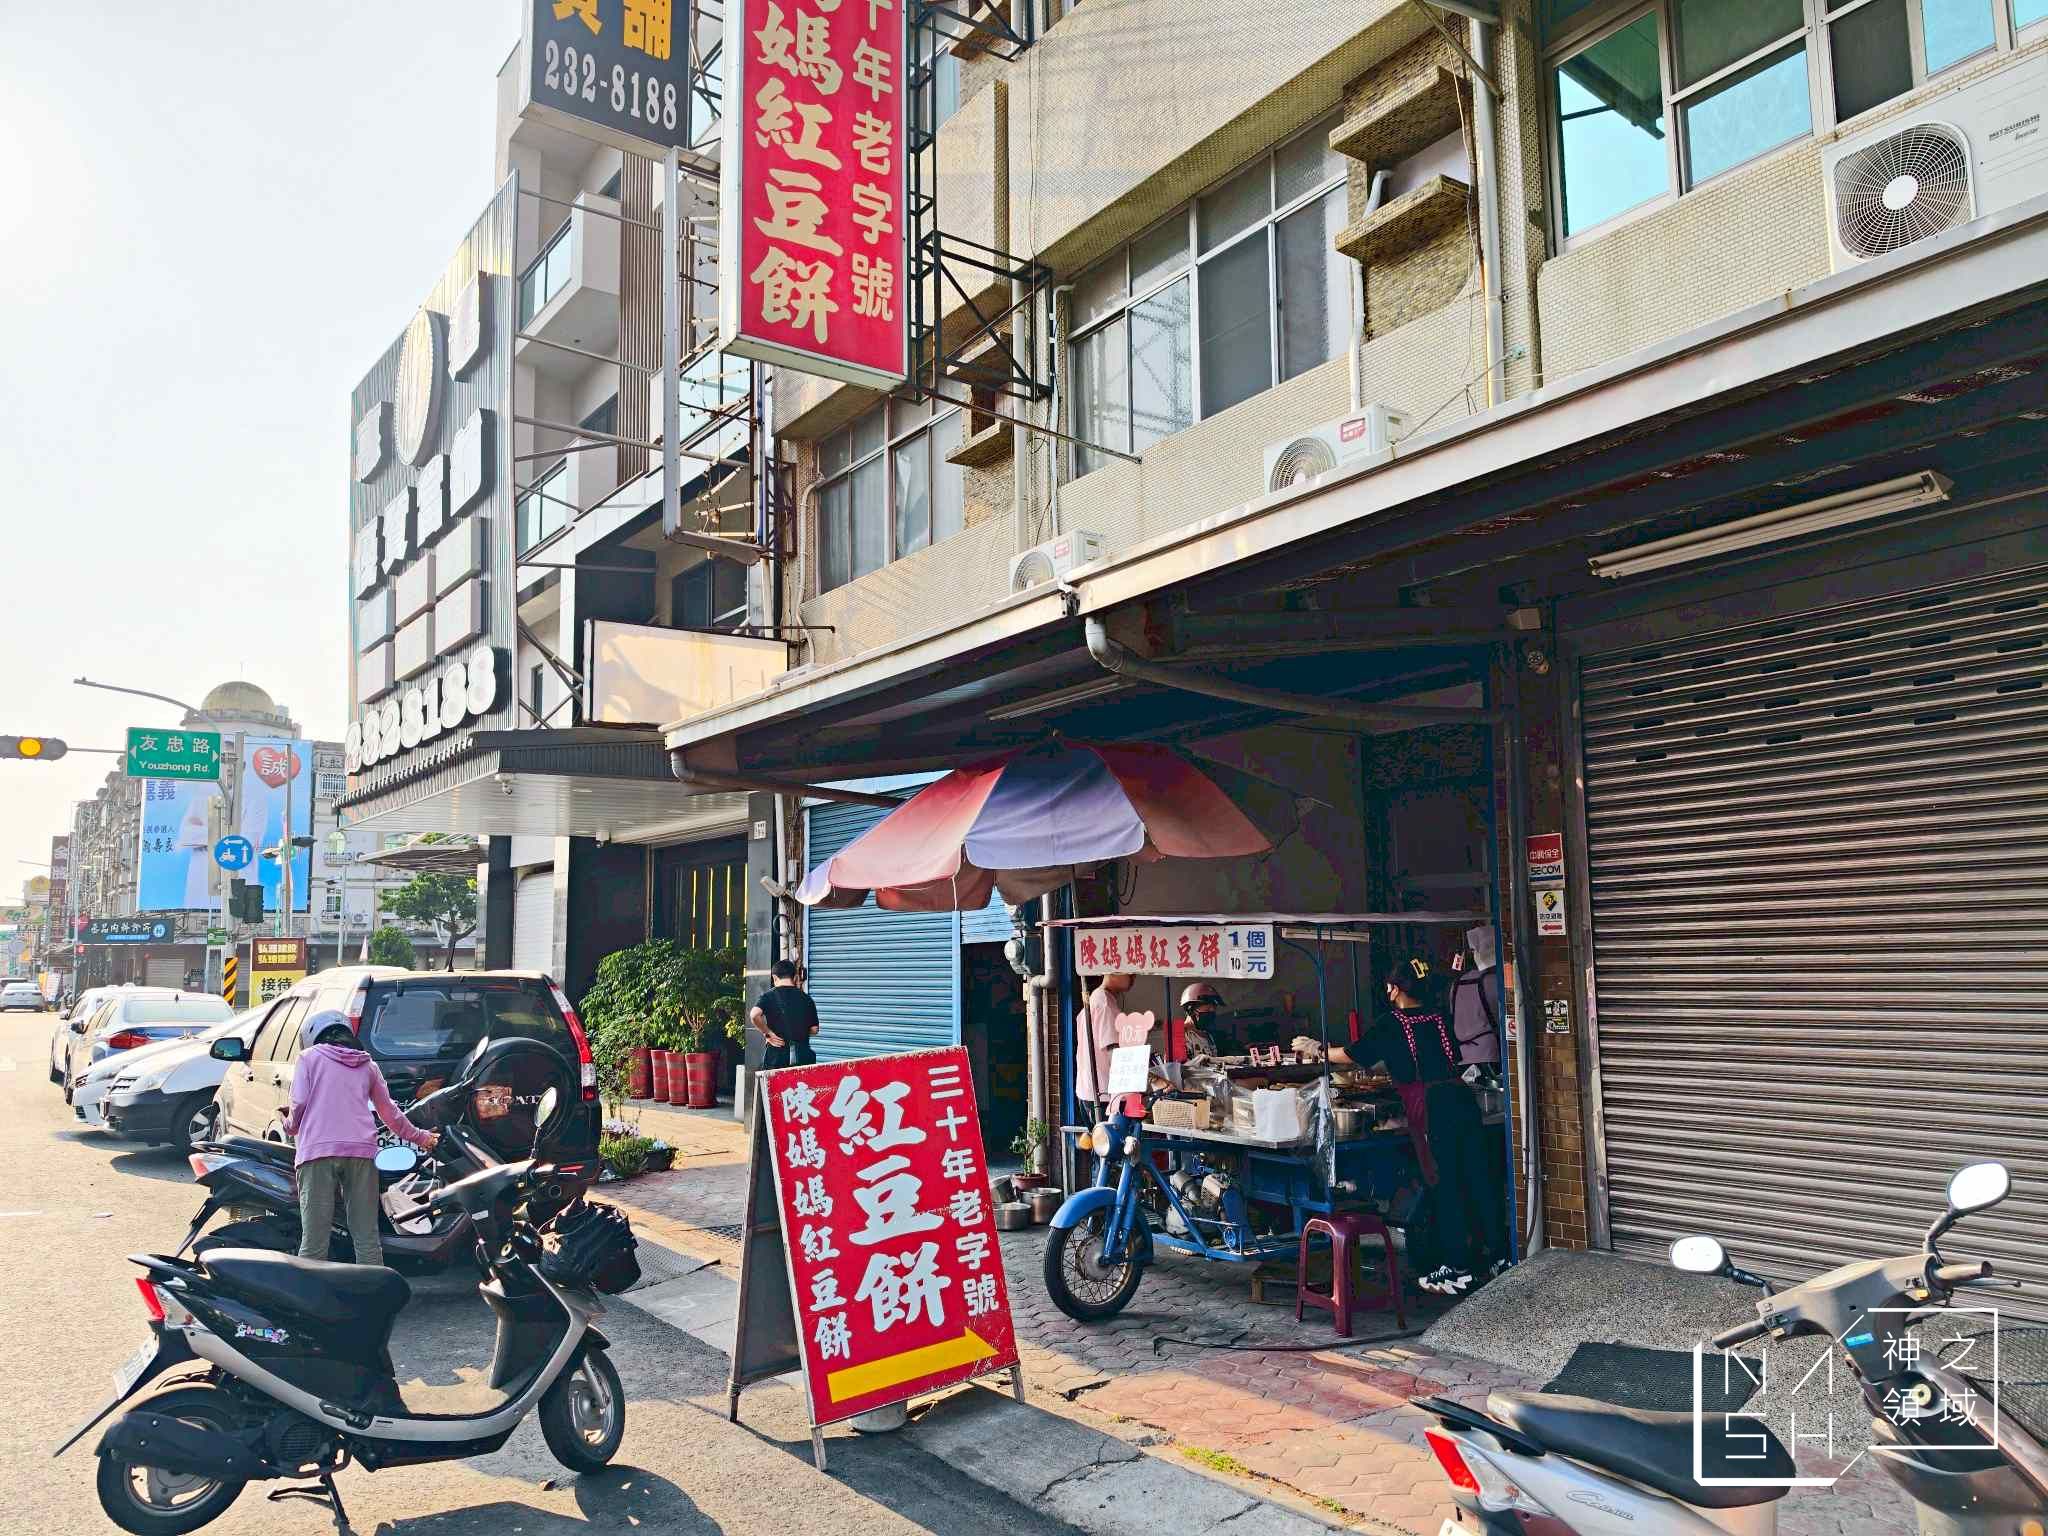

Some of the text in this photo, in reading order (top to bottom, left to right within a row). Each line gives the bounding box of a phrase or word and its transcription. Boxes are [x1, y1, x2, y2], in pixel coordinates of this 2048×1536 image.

[544, 39, 677, 130] 232-8188
[750, 0, 845, 344] 媽紅豆餅
[138, 760, 191, 774] Youzhong
[139, 735, 210, 754] 友忠路
[1530, 865, 1561, 874] SECOM
[261, 977, 292, 991] 接待
[1080, 933, 1220, 973] 陳媽媽紅豆餅
[781, 1081, 853, 1360] 陳媽媽紅豆餅
[828, 1074, 952, 1333] 紅豆餅
[927, 1064, 1000, 1318] 三十年老字號
